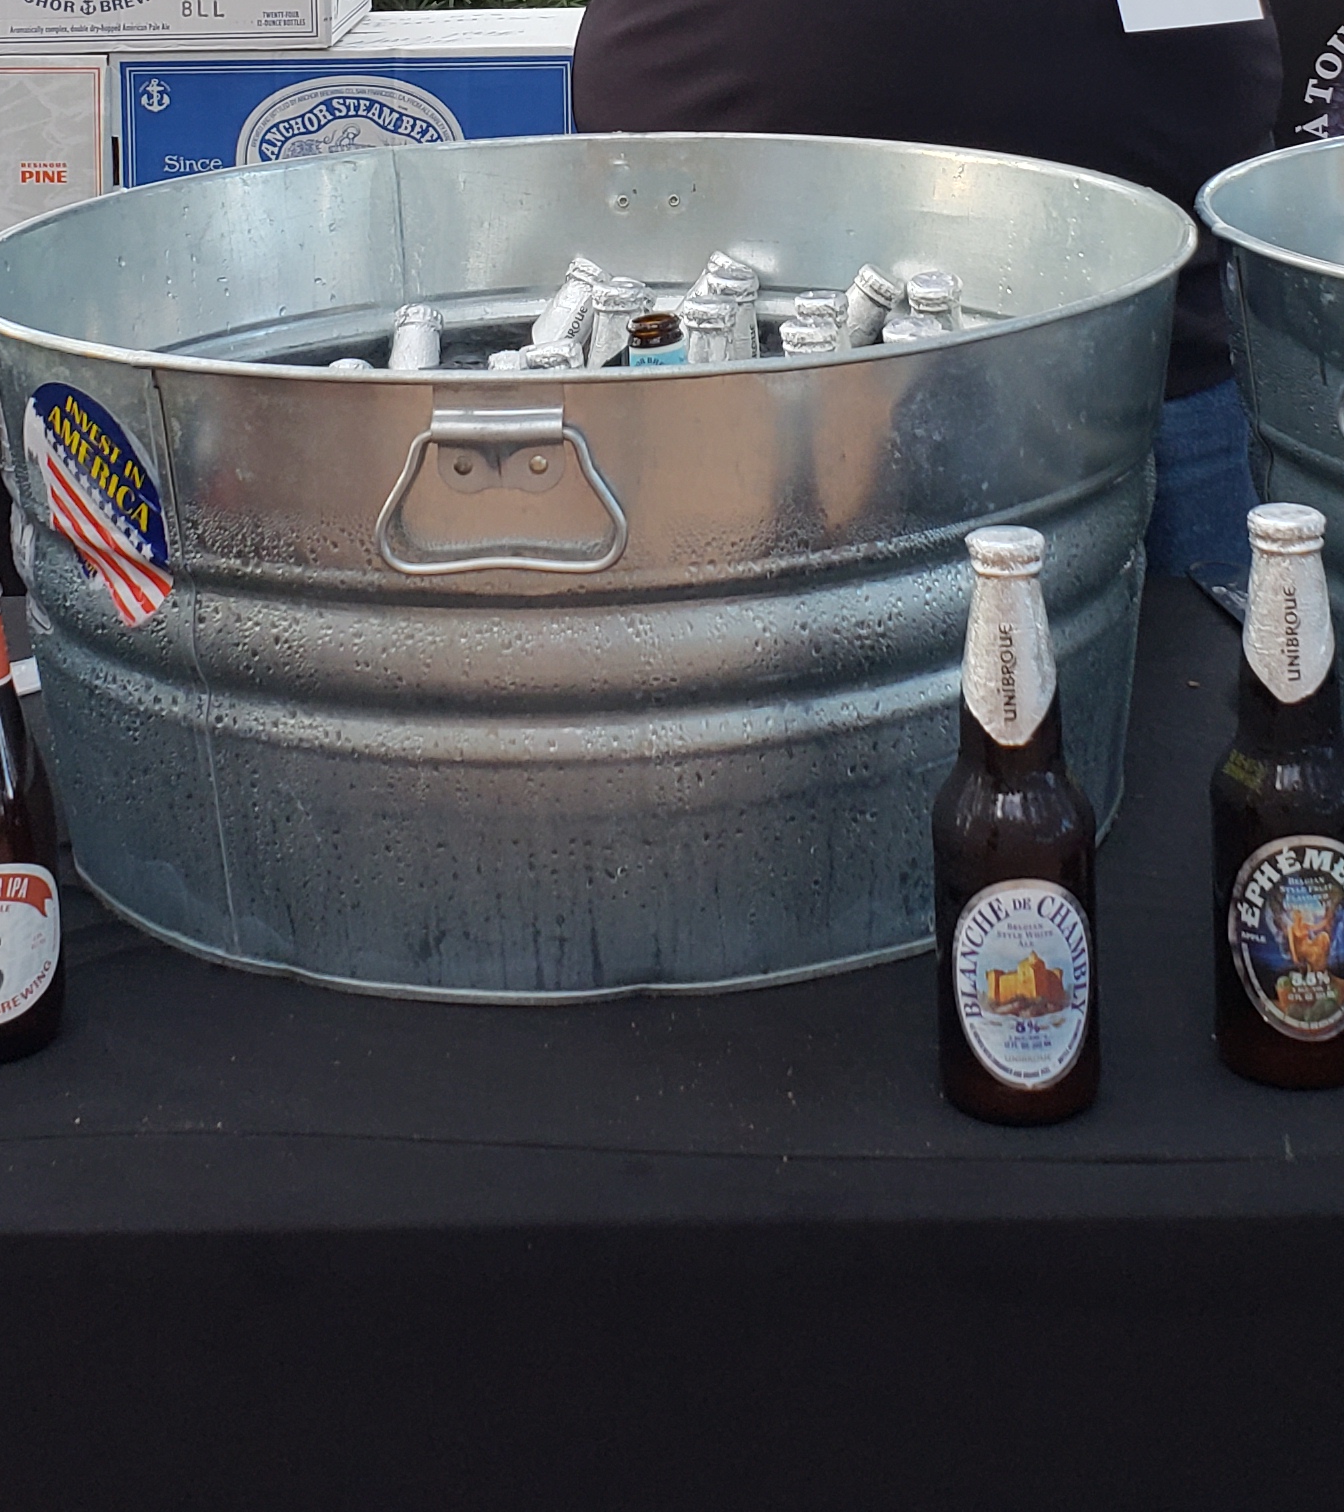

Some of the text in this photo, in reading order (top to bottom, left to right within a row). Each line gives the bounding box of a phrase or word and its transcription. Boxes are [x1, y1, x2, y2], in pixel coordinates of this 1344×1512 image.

[21, 170, 67, 184] PINE
[163, 154, 224, 174] Since
[261, 104, 333, 161] ANCHOR
[333, 98, 399, 130] STEAM
[399, 116, 443, 144] BEE
[48, 405, 149, 533] AMERICA
[65, 394, 146, 490] INVEST IN
[998, 623, 1017, 722] UNIBROUE
[1281, 586, 1301, 682] UNIBROUE
[6, 877, 29, 898] IPA
[960, 895, 1088, 1018] BLANCHE DE CHAMBLY
